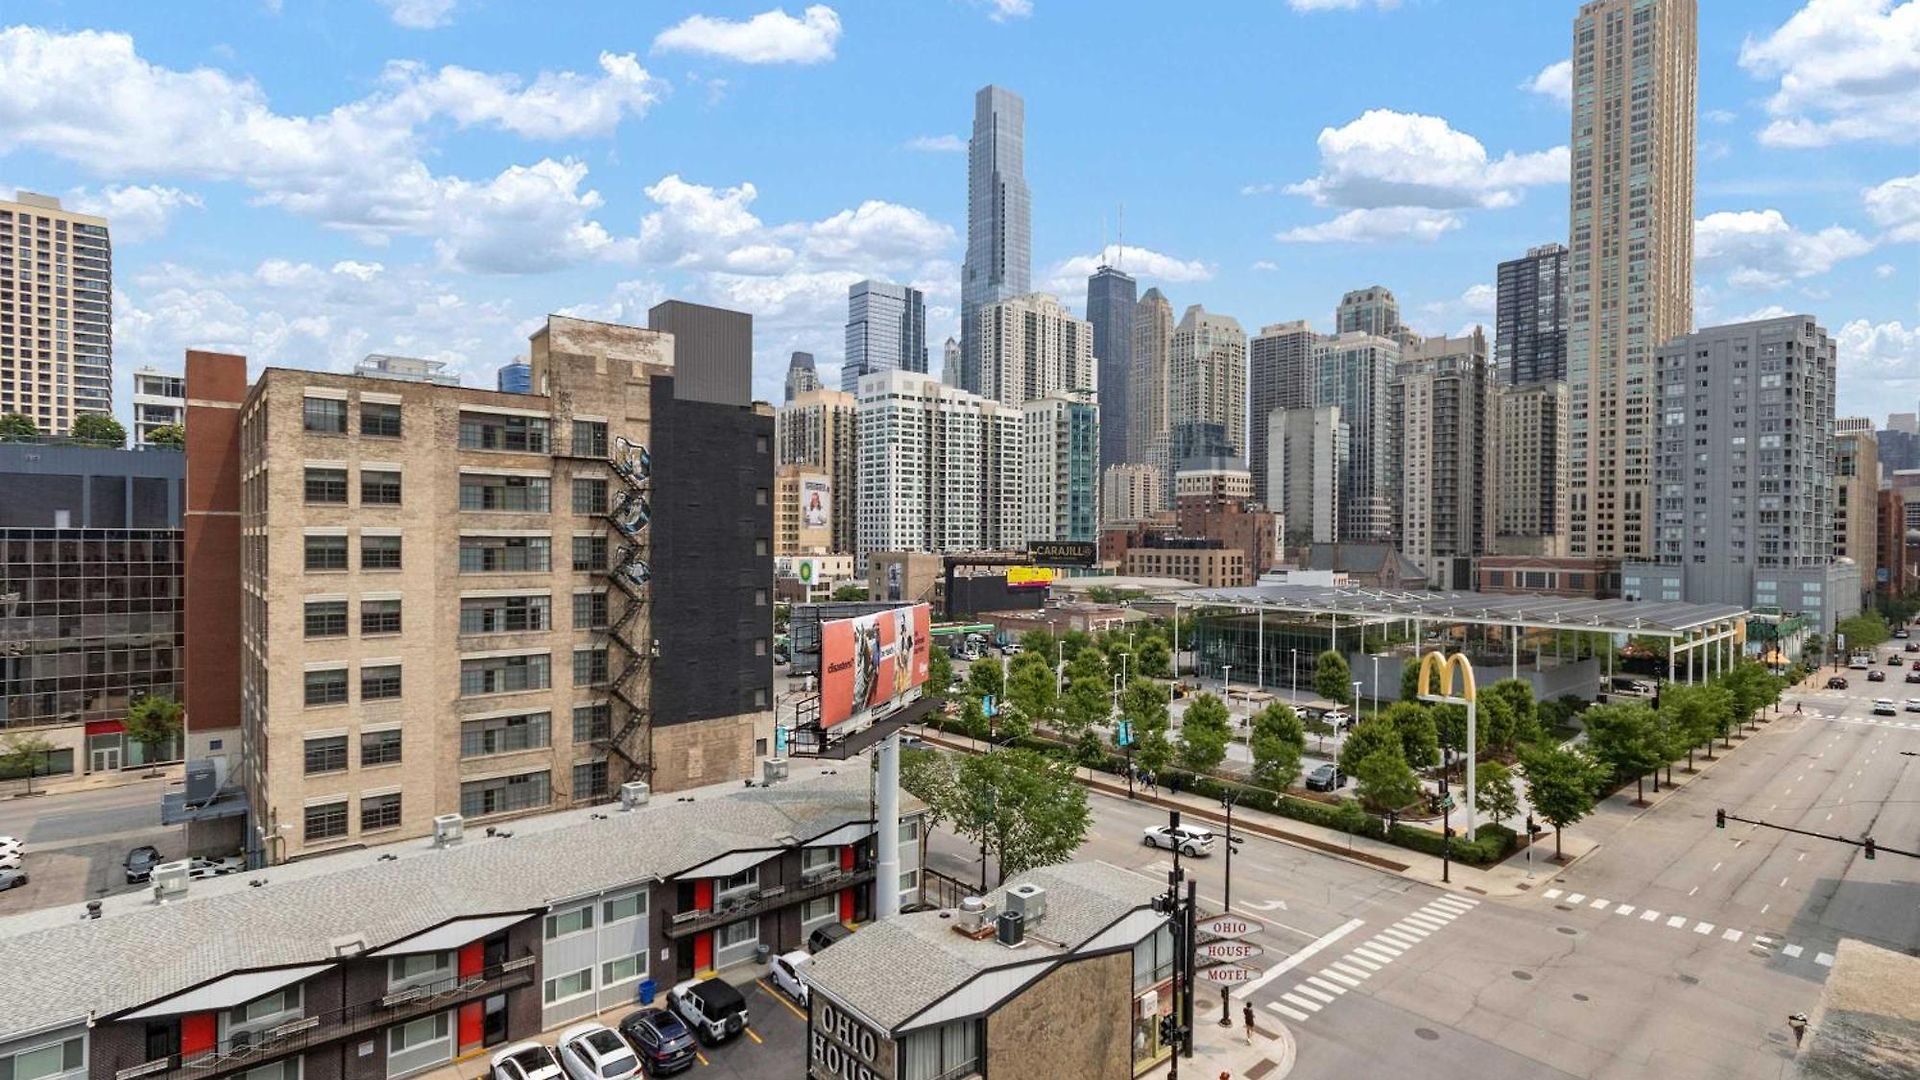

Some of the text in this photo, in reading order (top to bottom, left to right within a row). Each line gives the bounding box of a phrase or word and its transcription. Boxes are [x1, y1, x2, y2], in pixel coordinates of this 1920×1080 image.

[1213, 922, 1247, 933] OHIO
[1208, 945, 1251, 957] HOUSE
[1208, 969, 1249, 981] MOTEL
[822, 1005, 875, 1062] OHIO
[811, 1031, 882, 1080] HOUS
